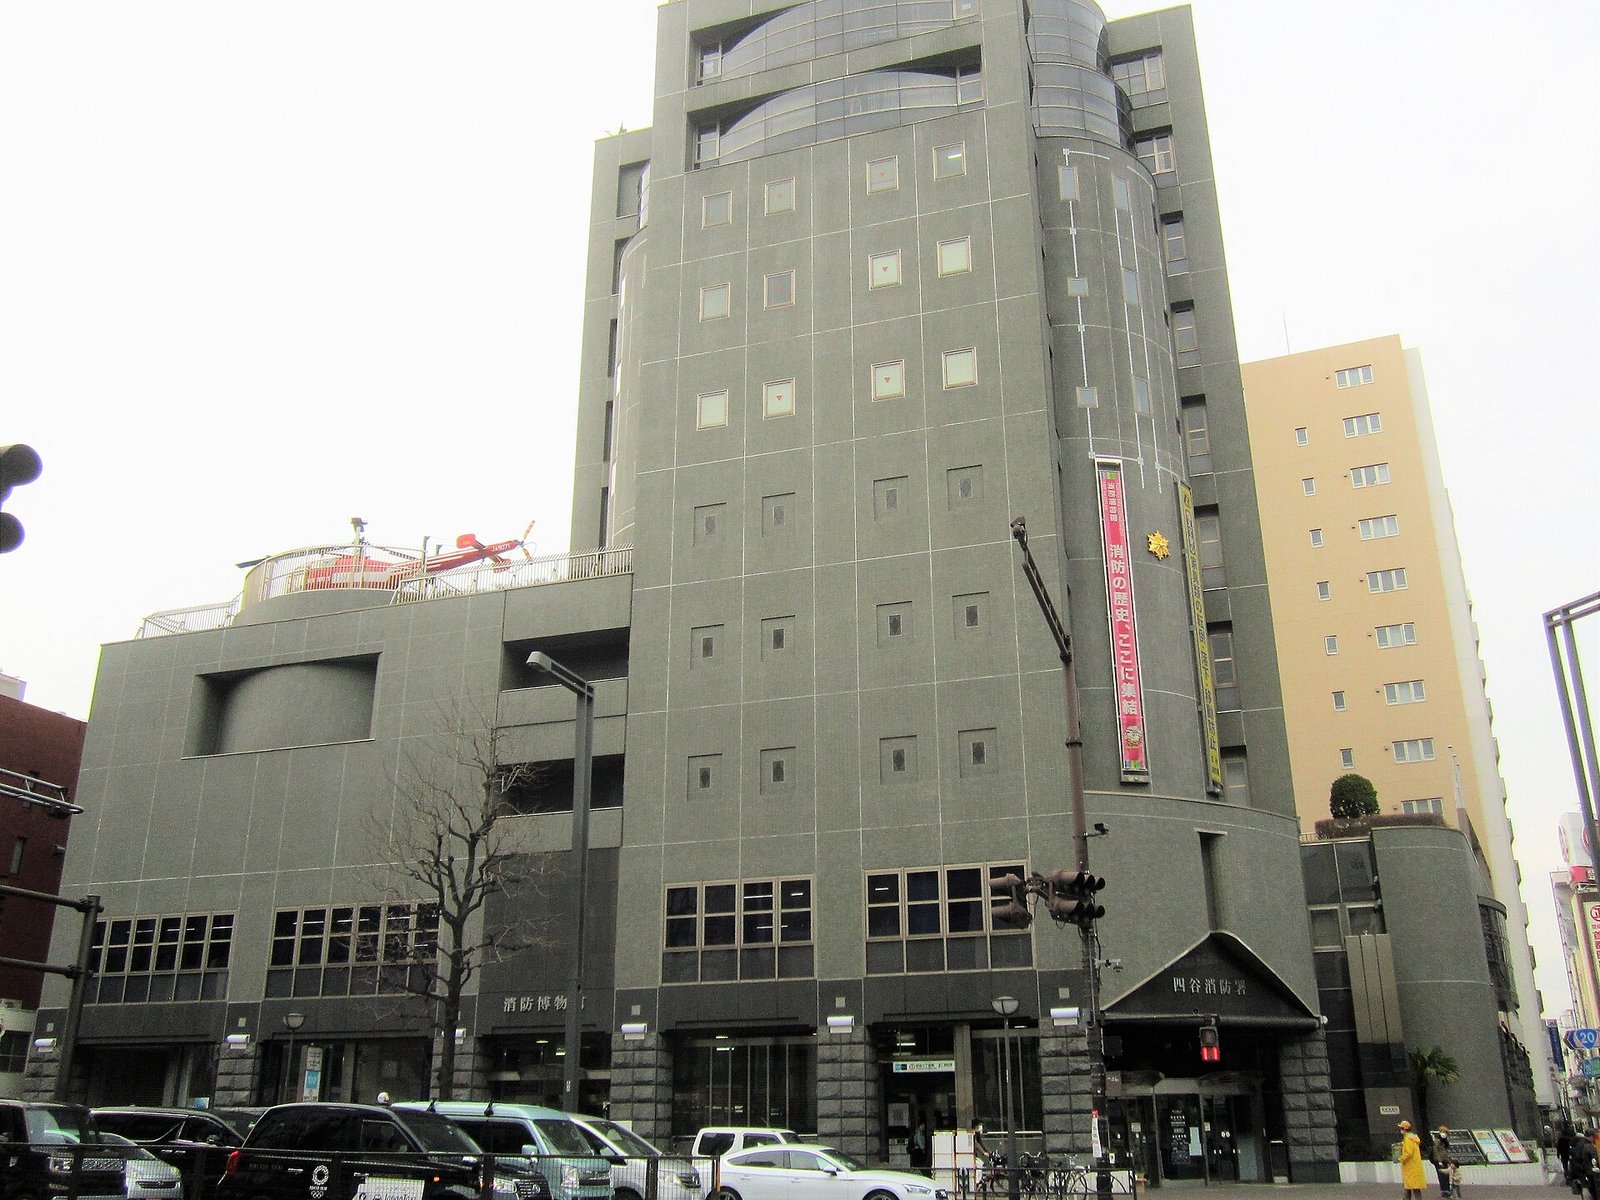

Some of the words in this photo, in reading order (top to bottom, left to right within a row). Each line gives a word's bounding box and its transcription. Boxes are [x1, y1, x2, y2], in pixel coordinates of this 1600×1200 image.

[1110, 544, 1138, 715] 消防の歴史、ここに集結
[1173, 977, 1246, 995] 四谷消防署
[503, 995, 586, 1012] 消防博物
[1580, 1032, 1595, 1043] 20
